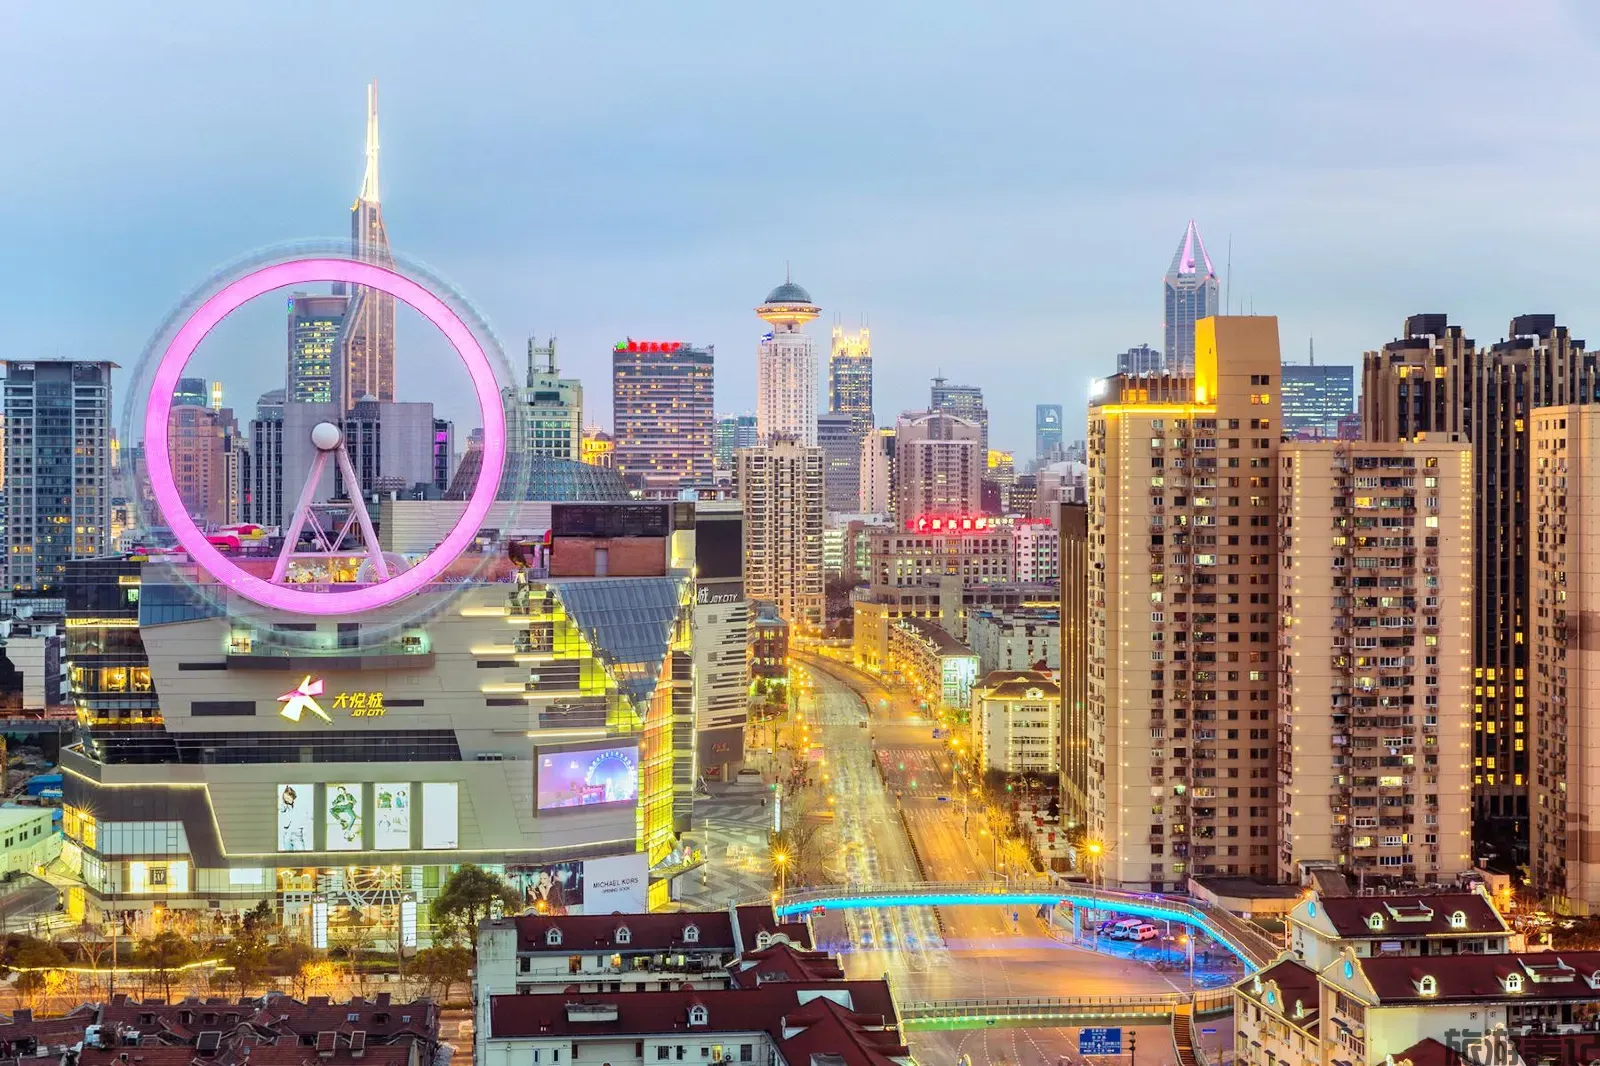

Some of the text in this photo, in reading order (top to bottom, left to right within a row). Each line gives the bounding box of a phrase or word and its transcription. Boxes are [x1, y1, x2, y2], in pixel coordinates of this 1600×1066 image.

[710, 594, 738, 603] JOY CITY
[332, 692, 383, 708] 大悦城
[593, 880, 620, 888] MICHAEL
